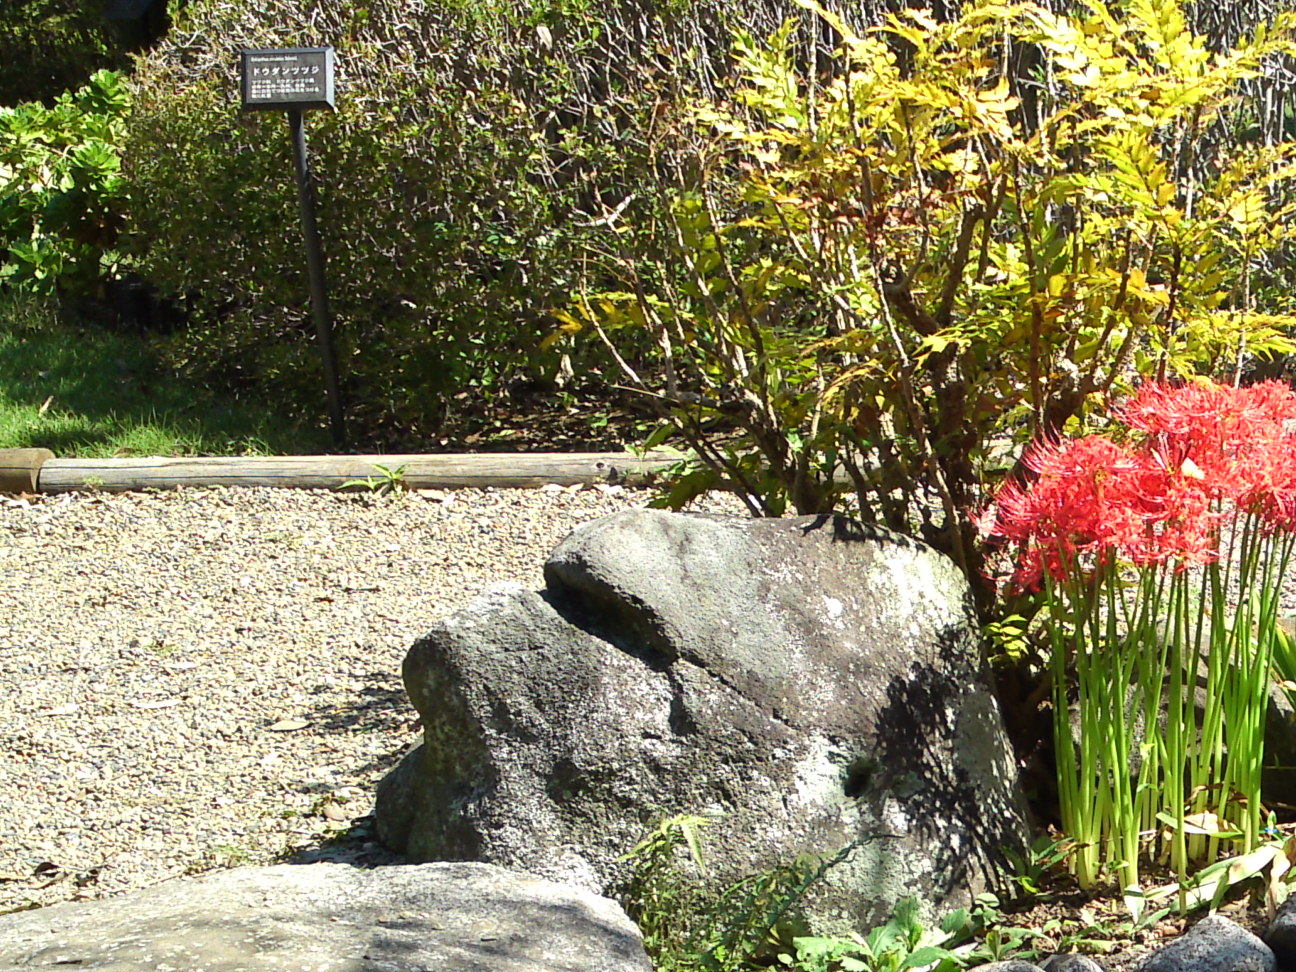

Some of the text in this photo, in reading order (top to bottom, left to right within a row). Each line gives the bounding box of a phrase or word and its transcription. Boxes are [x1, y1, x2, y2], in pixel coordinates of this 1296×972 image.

[253, 66, 320, 77] ドウダンツツジ
